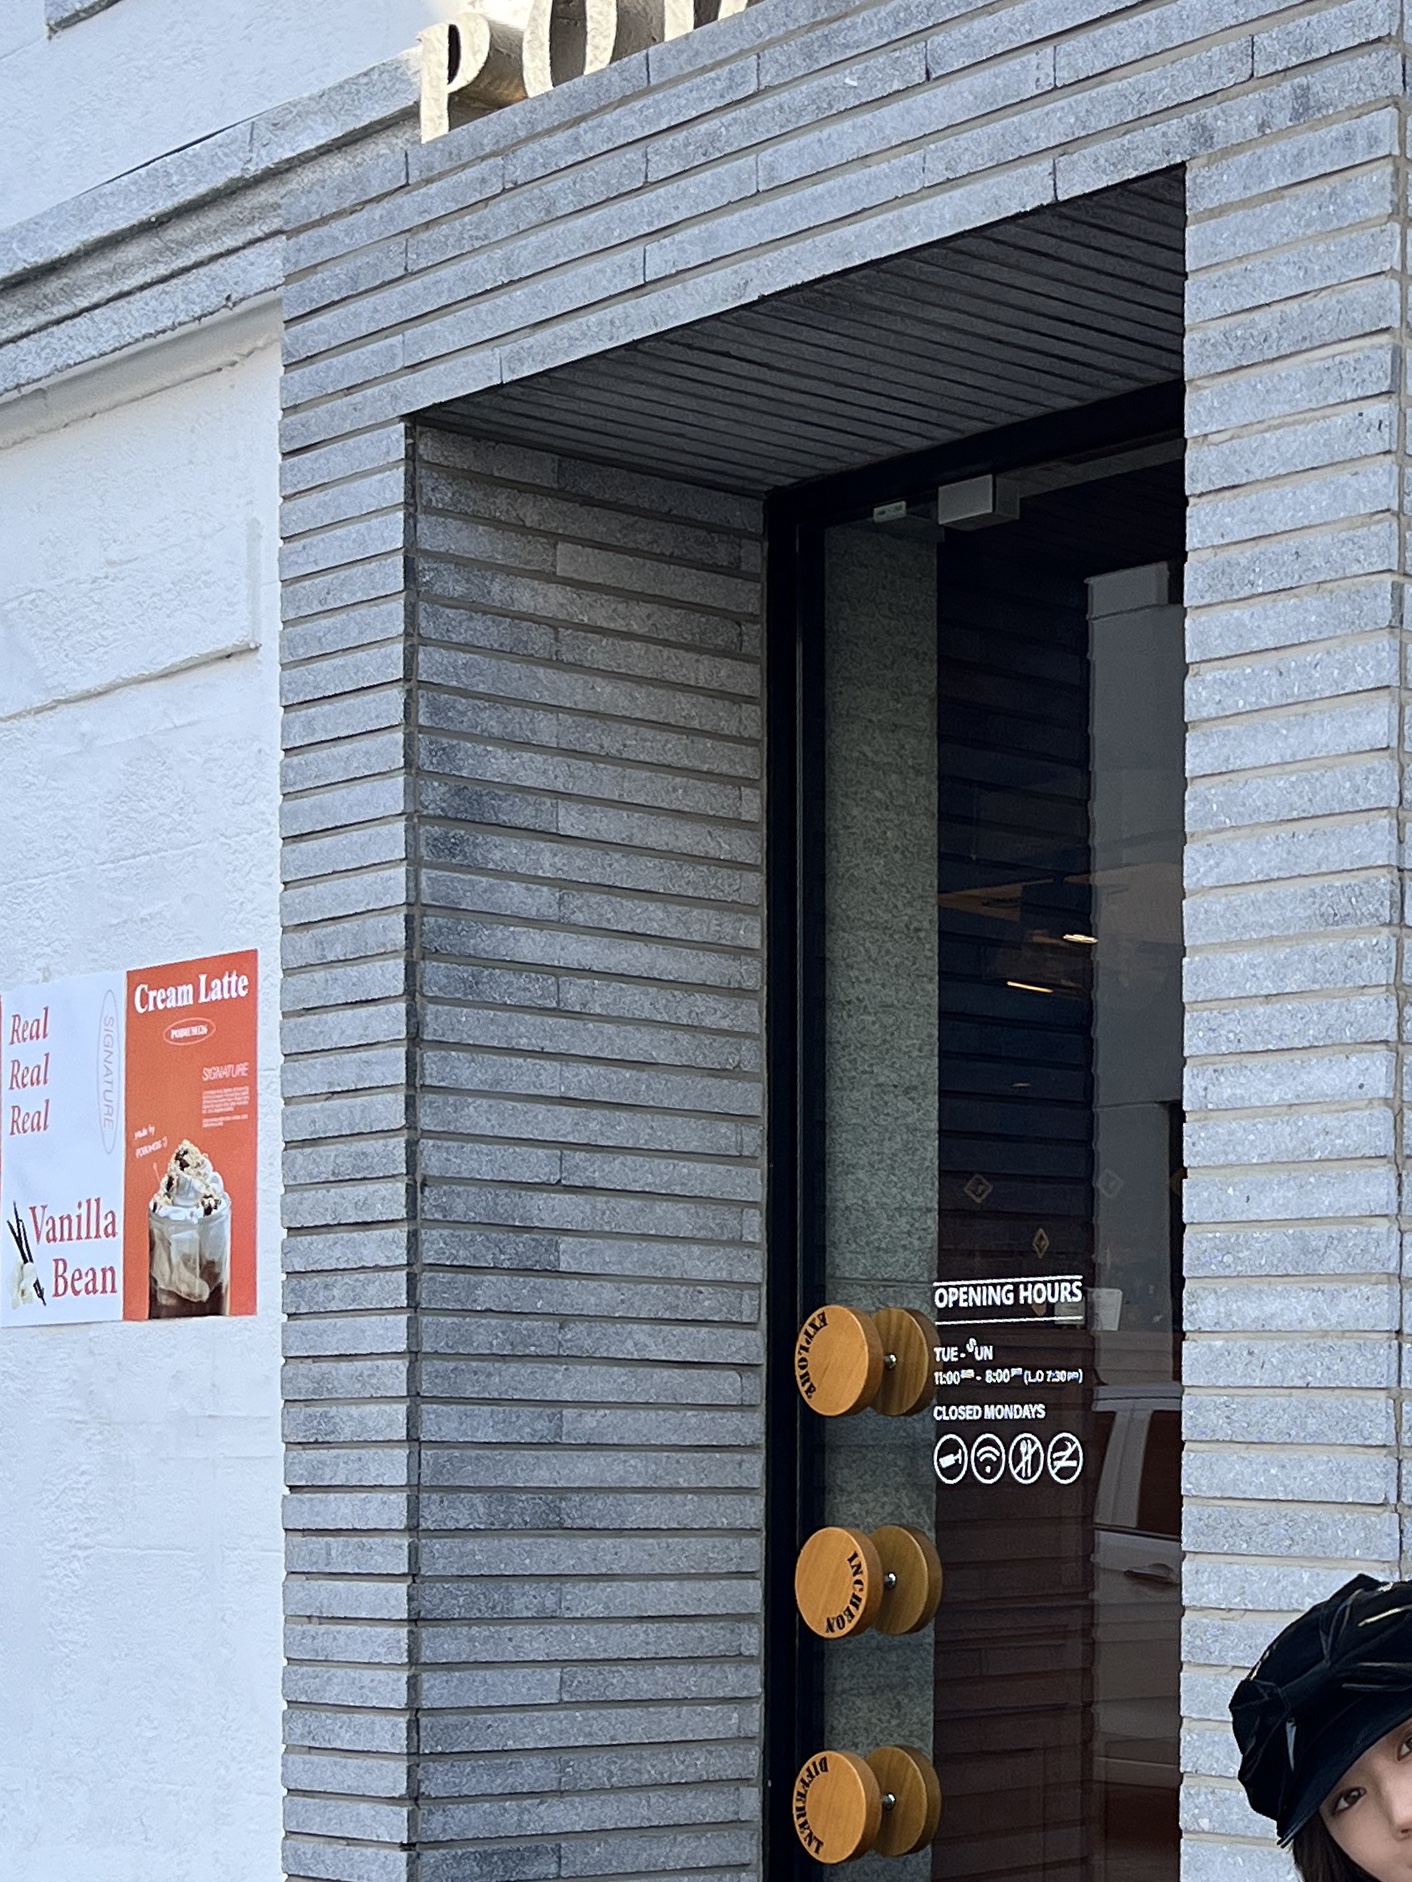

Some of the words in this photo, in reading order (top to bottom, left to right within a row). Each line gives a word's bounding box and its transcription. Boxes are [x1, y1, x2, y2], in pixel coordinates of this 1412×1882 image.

[133, 982, 195, 1014] Cream
[198, 972, 250, 1004] Latte
[8, 1005, 50, 1046] Real
[8, 1052, 50, 1091] Real
[103, 1016, 115, 1131] SIGNATURE
[202, 1061, 250, 1081] SIGNATURE
[9, 1099, 50, 1136] Real
[28, 1196, 118, 1245] Vanilla
[51, 1257, 118, 1300] Bean
[934, 1283, 1014, 1309] OPENING
[1018, 1281, 1083, 1305] HOURS
[933, 1346, 959, 1362] TUE
[933, 1405, 982, 1421] CLOSED
[983, 1403, 1046, 1420] MONDAYS
[825, 1550, 864, 1634] INCHEON
[795, 1756, 829, 1855] DIFFERENT
